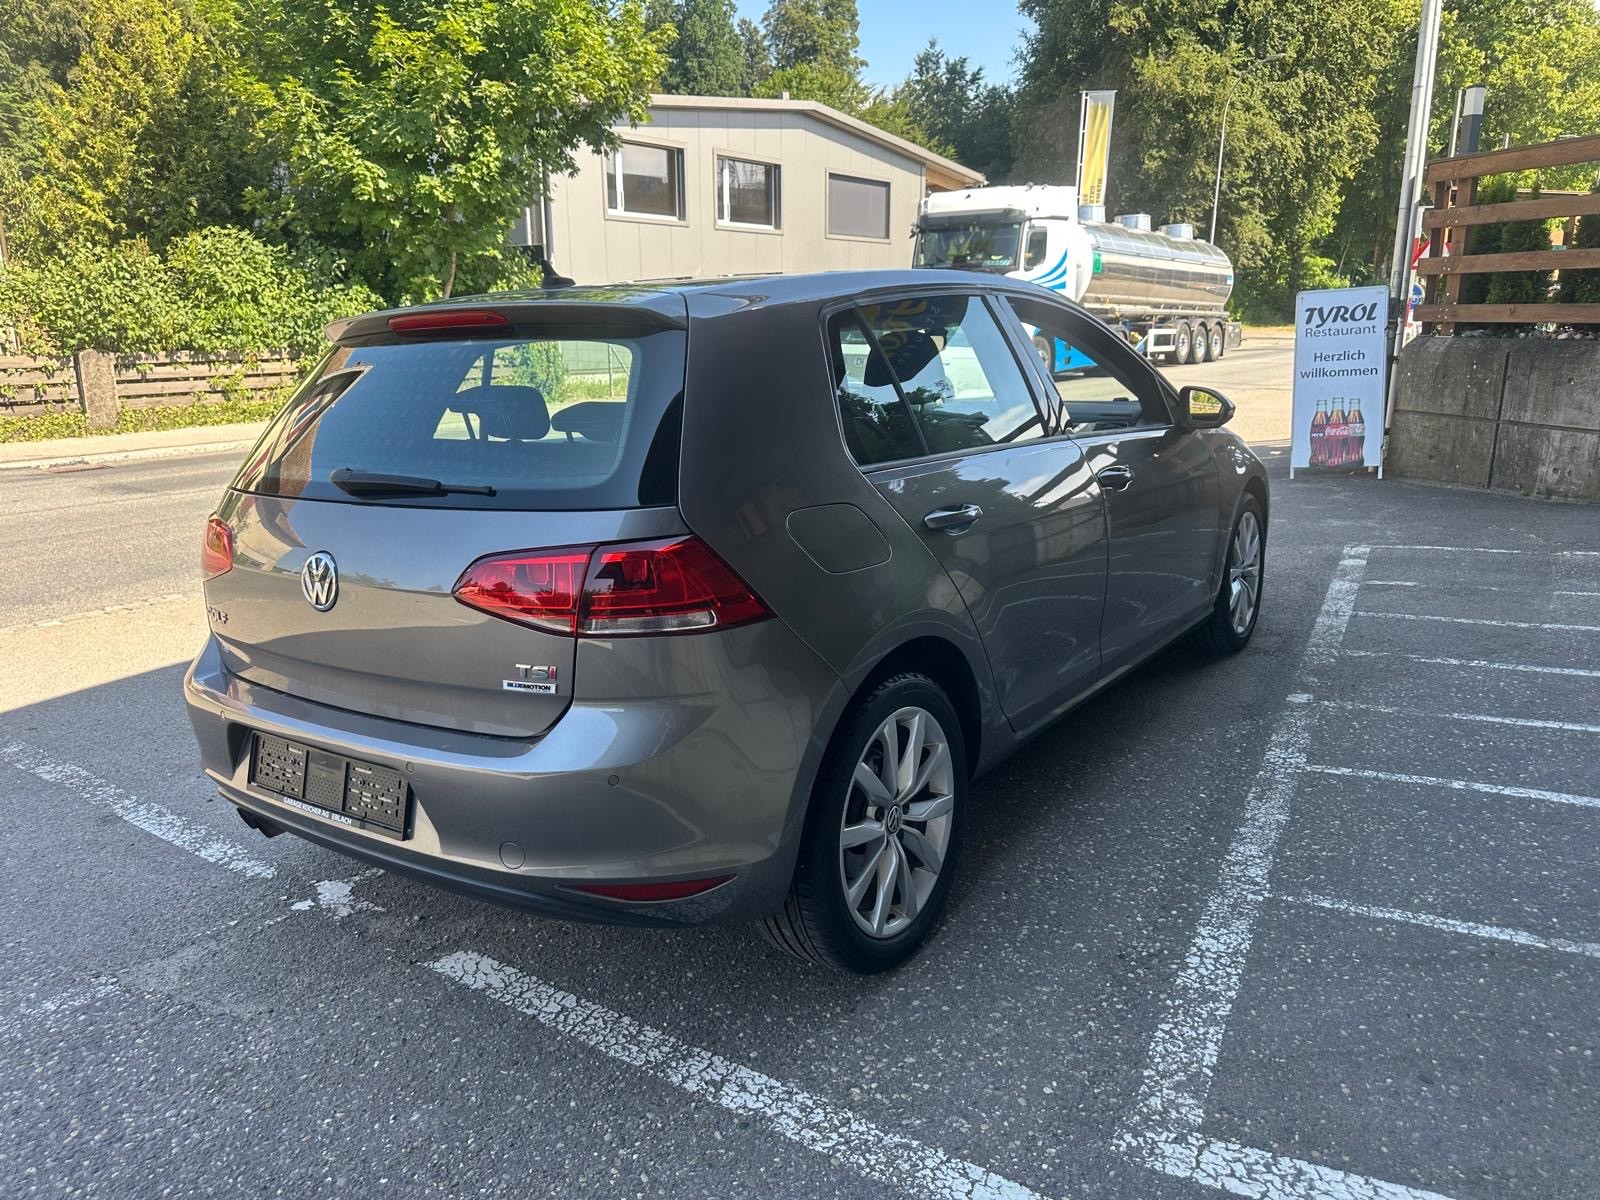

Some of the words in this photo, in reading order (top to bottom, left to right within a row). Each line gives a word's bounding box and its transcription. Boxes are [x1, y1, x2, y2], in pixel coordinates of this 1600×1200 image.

[1305, 302, 1378, 329] TYROL
[1305, 324, 1377, 338] Restaurant
[1313, 349, 1366, 363] Herzlich
[1300, 367, 1378, 379] willkommen
[515, 663, 557, 681] TSI
[506, 682, 551, 690] BLUEMOTION
[283, 796, 303, 808] GARAGE
[302, 803, 321, 815] KOCHER
[321, 810, 329, 818] AG
[331, 813, 352, 825] ERLACH
